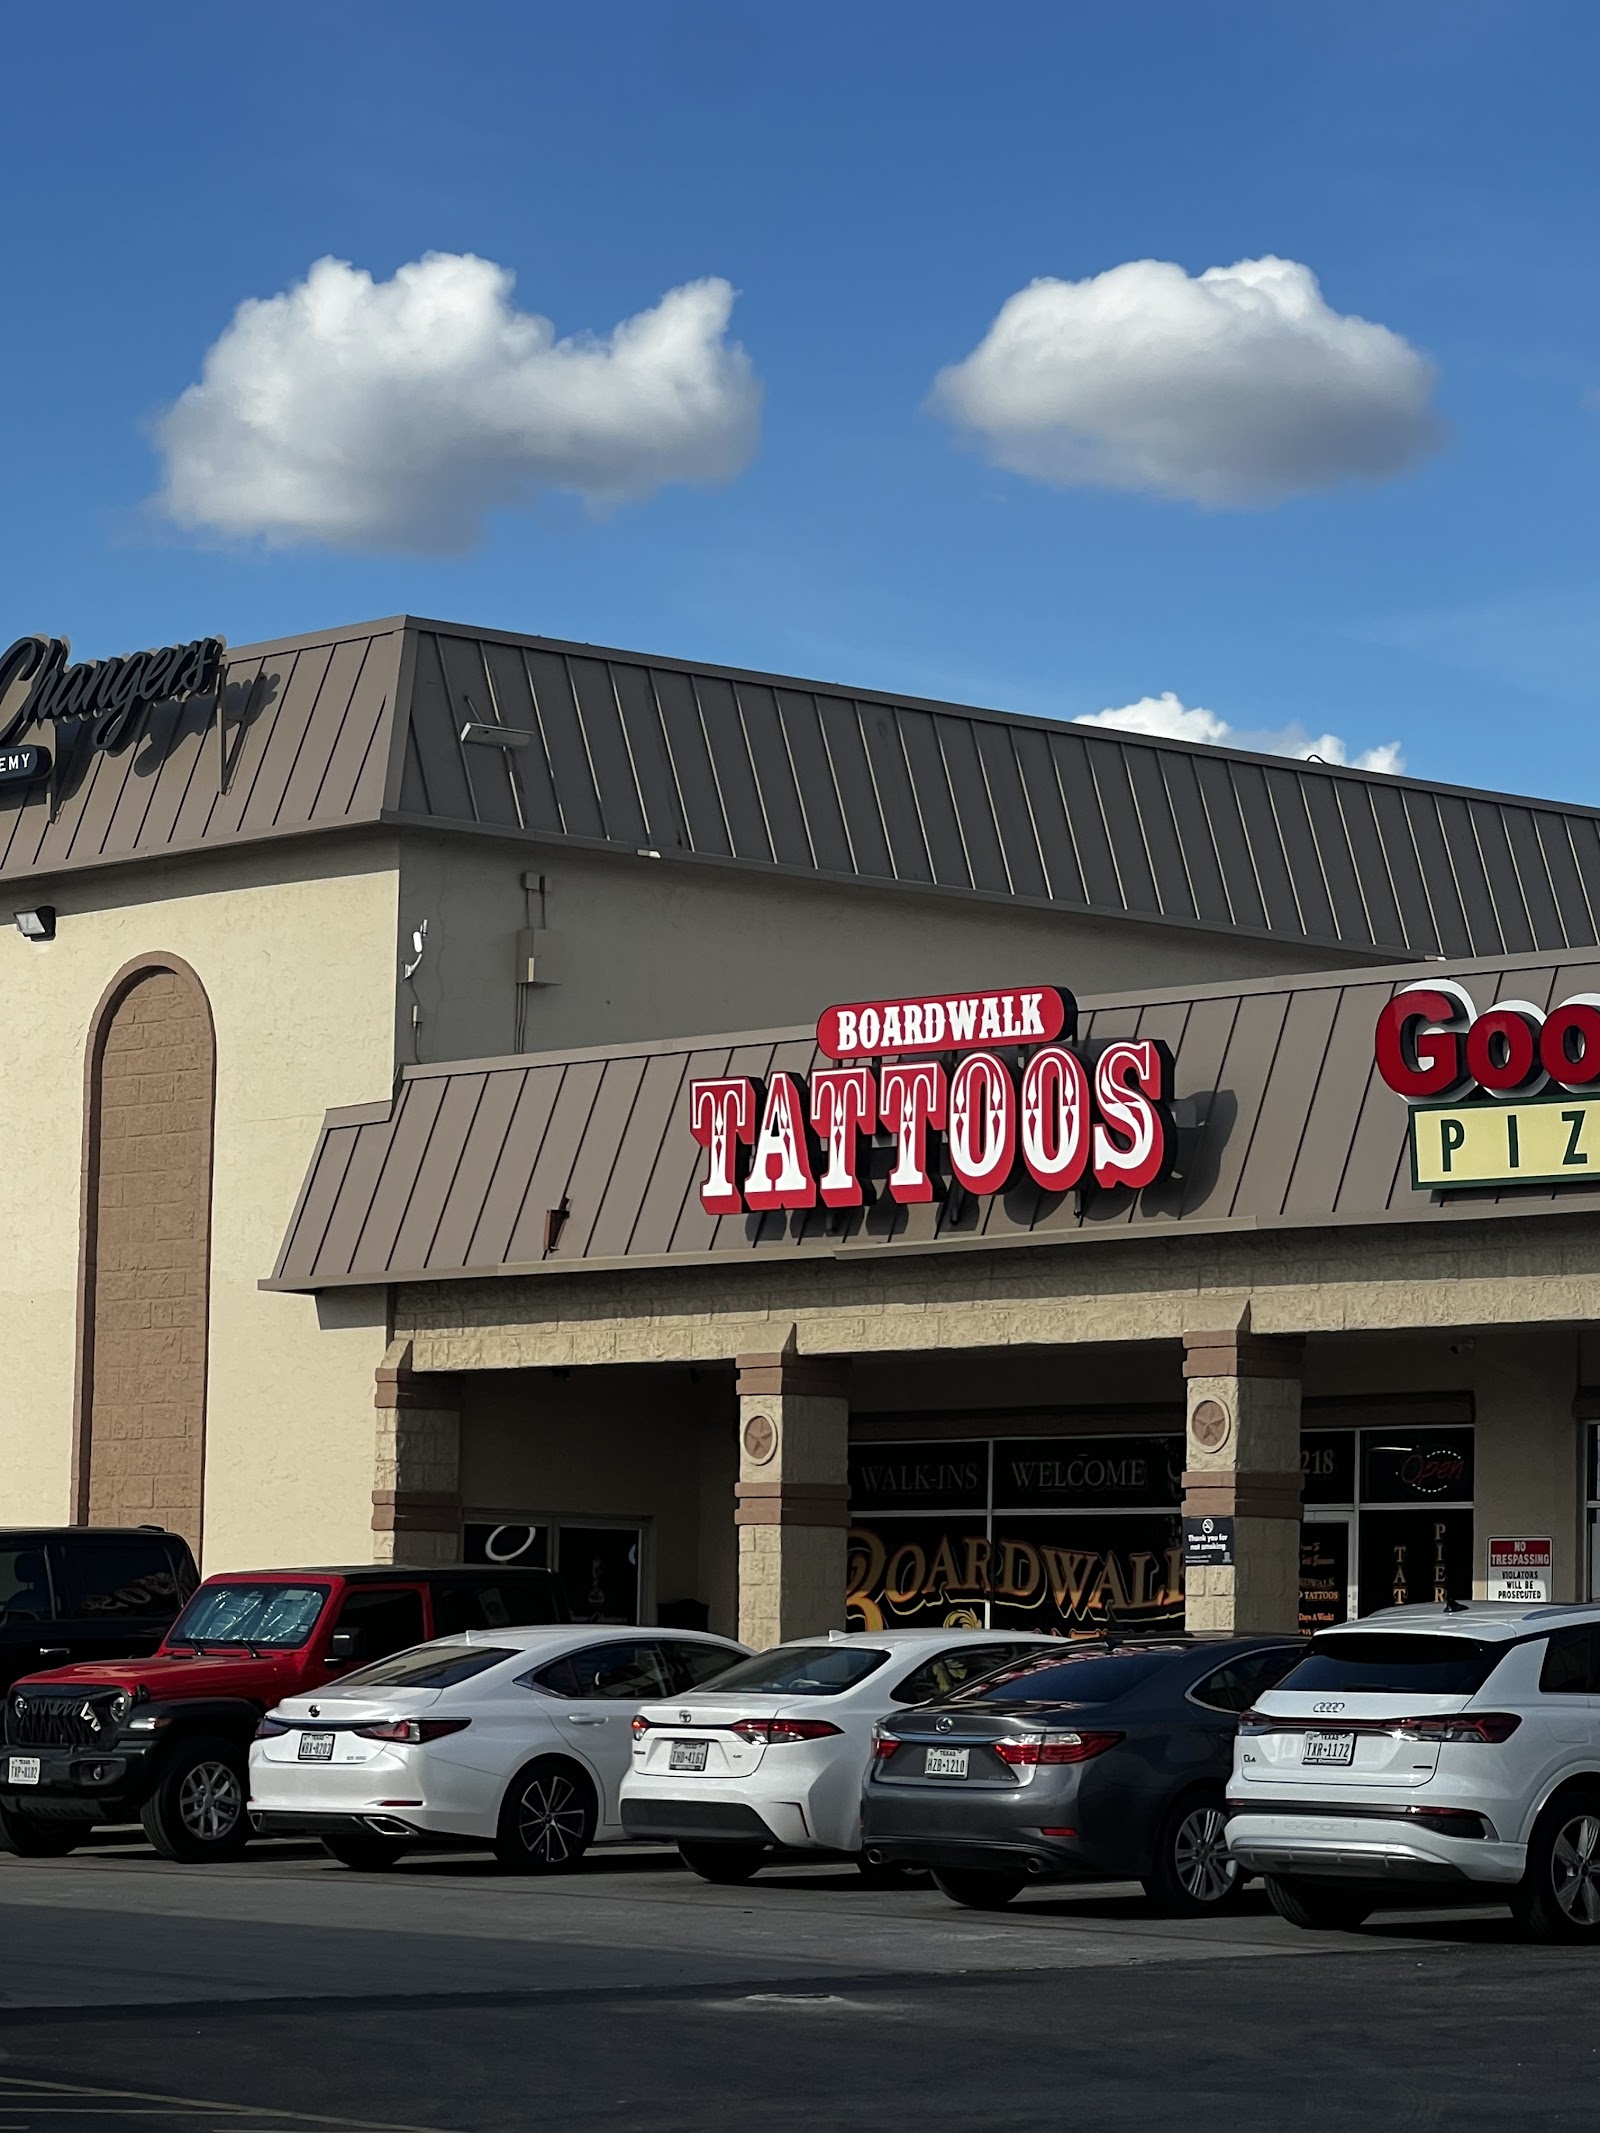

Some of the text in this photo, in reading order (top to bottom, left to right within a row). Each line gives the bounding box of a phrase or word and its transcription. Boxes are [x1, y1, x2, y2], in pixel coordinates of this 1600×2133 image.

[836, 993, 1045, 1052] BOARDWALK
[690, 1039, 1164, 1216] TATTOOS
[1440, 1109, 1589, 1173] PIZ
[861, 1459, 1146, 1491] WALK-INS WELCOME
[1401, 1454, 1464, 1486] Open
[1188, 1533, 1228, 1543] Thank you for
[1190, 1542, 1226, 1551] not smoking
[1514, 1541, 1527, 1552] NO
[1491, 1553, 1550, 1565] TRESPASSING
[1502, 1570, 1538, 1579] VIOLATORS
[1506, 1580, 1534, 1590] WILL BE
[1304, 1591, 1339, 1600] TATTOOS
[1498, 1590, 1541, 1600] PROSECUTED
[1321, 1733, 1339, 1741] TEXAS
